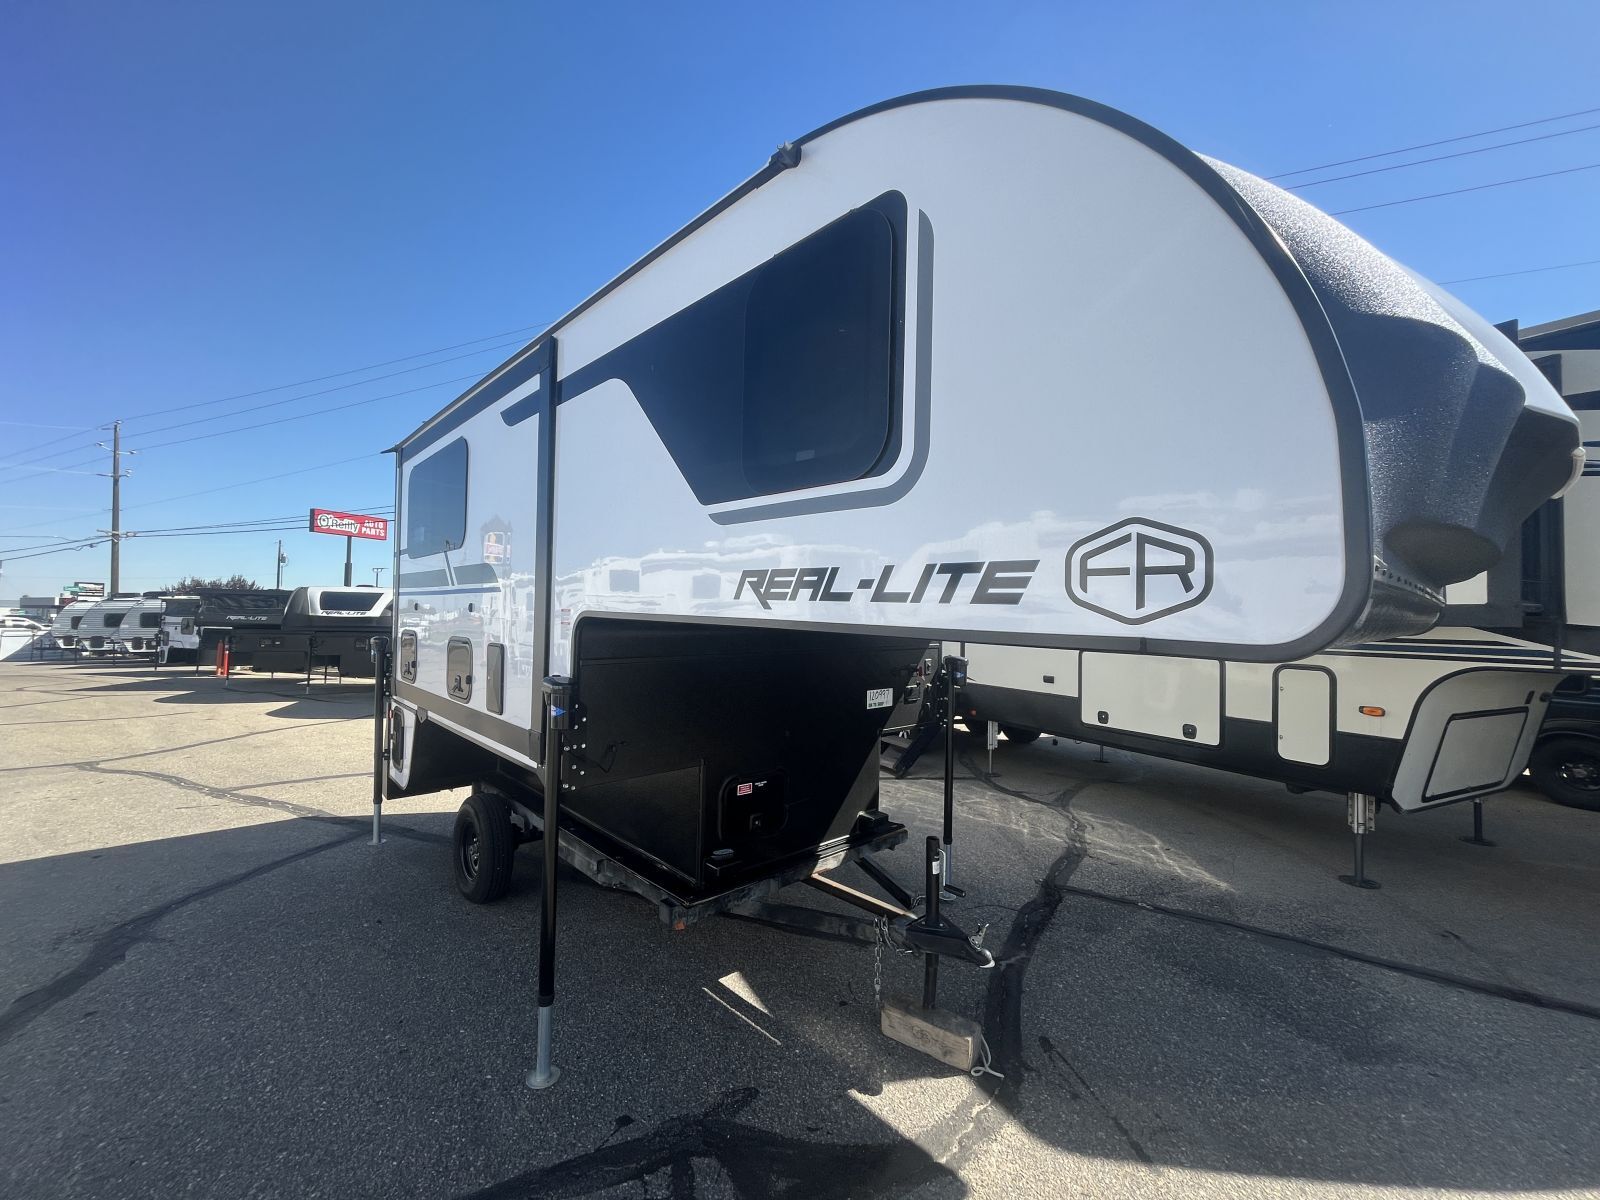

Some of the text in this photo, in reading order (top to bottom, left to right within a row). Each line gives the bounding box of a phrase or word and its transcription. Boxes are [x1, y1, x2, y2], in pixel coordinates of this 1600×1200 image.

[364, 520, 384, 529] AUTO
[361, 527, 385, 536] PARTS
[733, 559, 1040, 610] REAL-LITE
